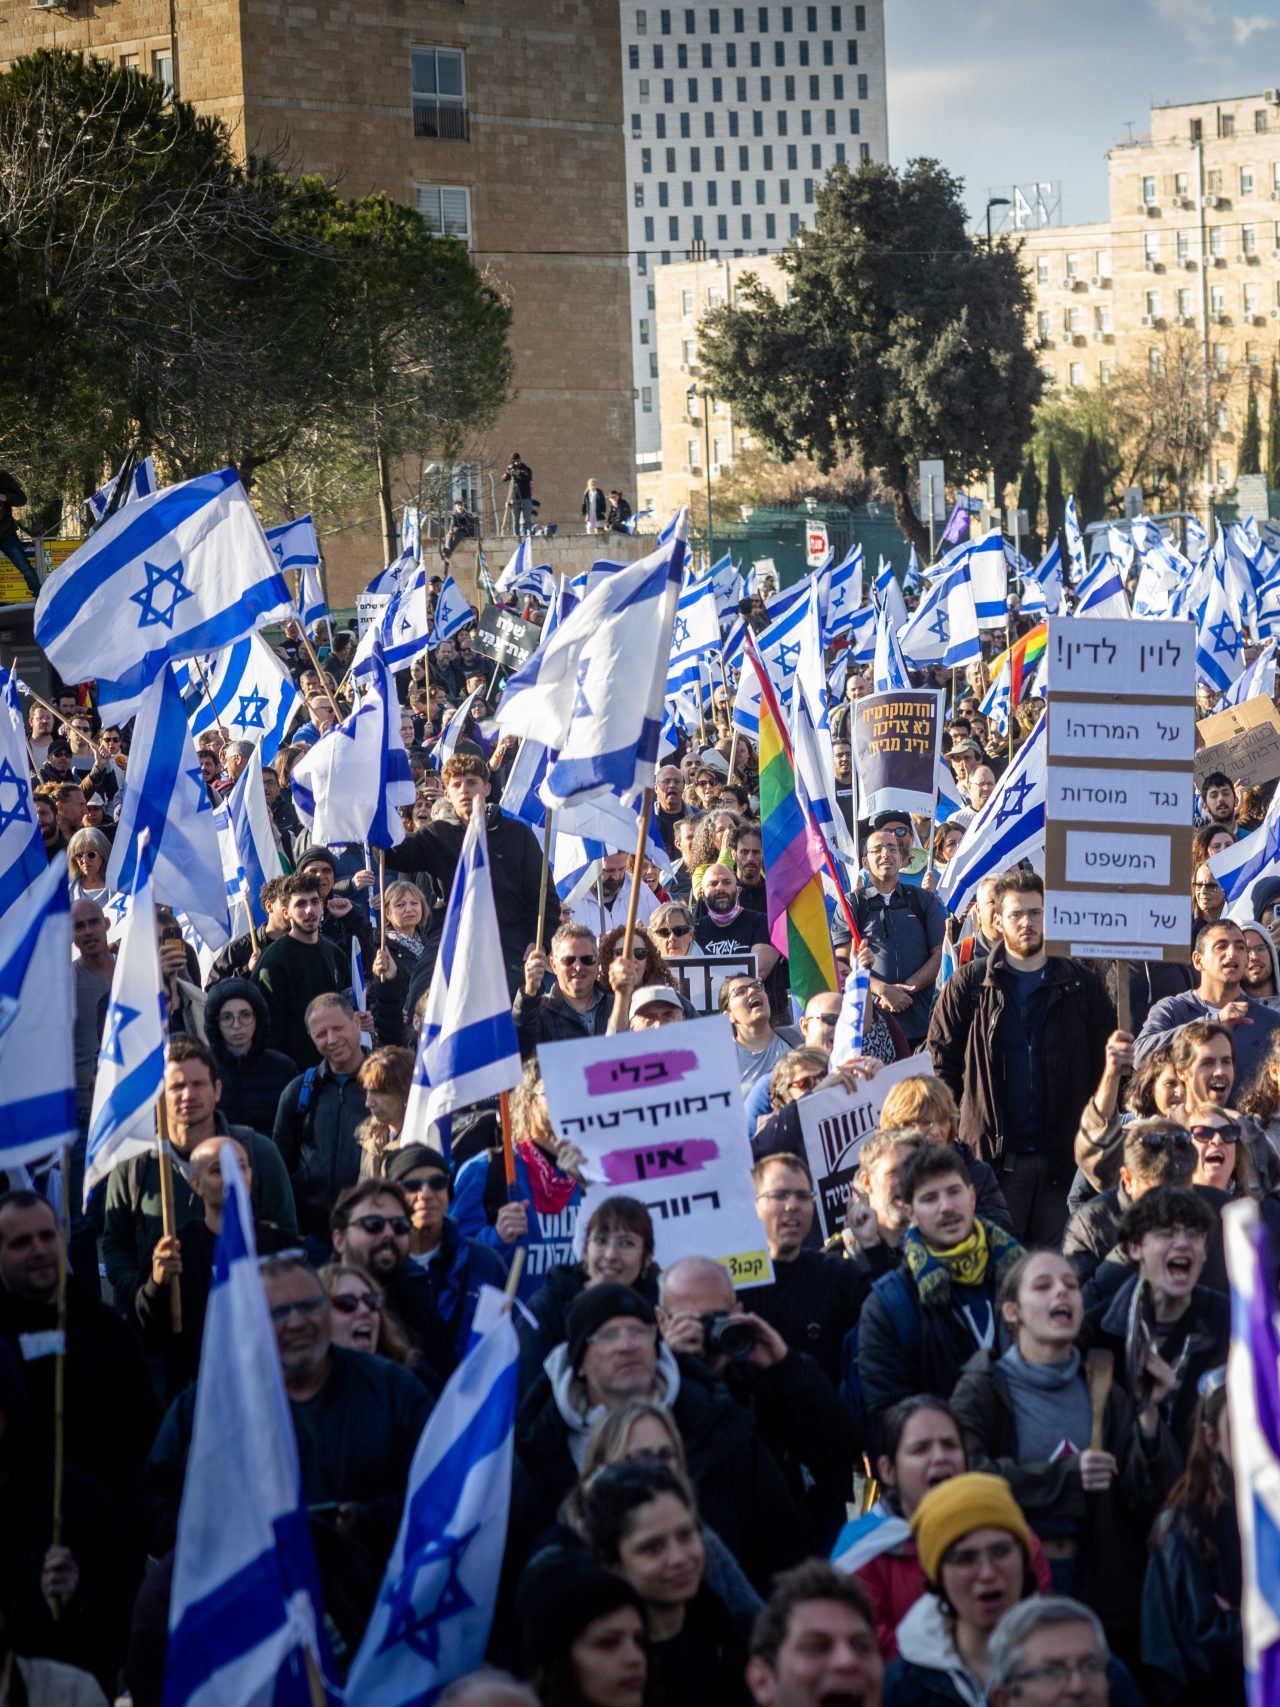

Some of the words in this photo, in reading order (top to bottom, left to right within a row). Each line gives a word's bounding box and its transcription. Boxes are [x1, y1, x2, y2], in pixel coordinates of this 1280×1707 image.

[1057, 635, 1117, 670] לדין!
[1140, 639, 1181, 673] לוין
[873, 720, 909, 737] צריכה
[913, 720, 930, 735] לא
[1066, 718, 1139, 740] המרדה!
[1157, 721, 1180, 741] על
[1061, 786, 1127, 804] מוסדות
[1149, 791, 1178, 807] נגד
[1085, 851, 1156, 869] המשפט
[1053, 906, 1127, 927] המדינה!
[1150, 908, 1177, 929] של
[611, 1061, 668, 1083] בלי
[560, 1091, 731, 1135] דמוקרטיה
[634, 1147, 688, 1180] אין
[728, 1257, 763, 1277] קבוצ
